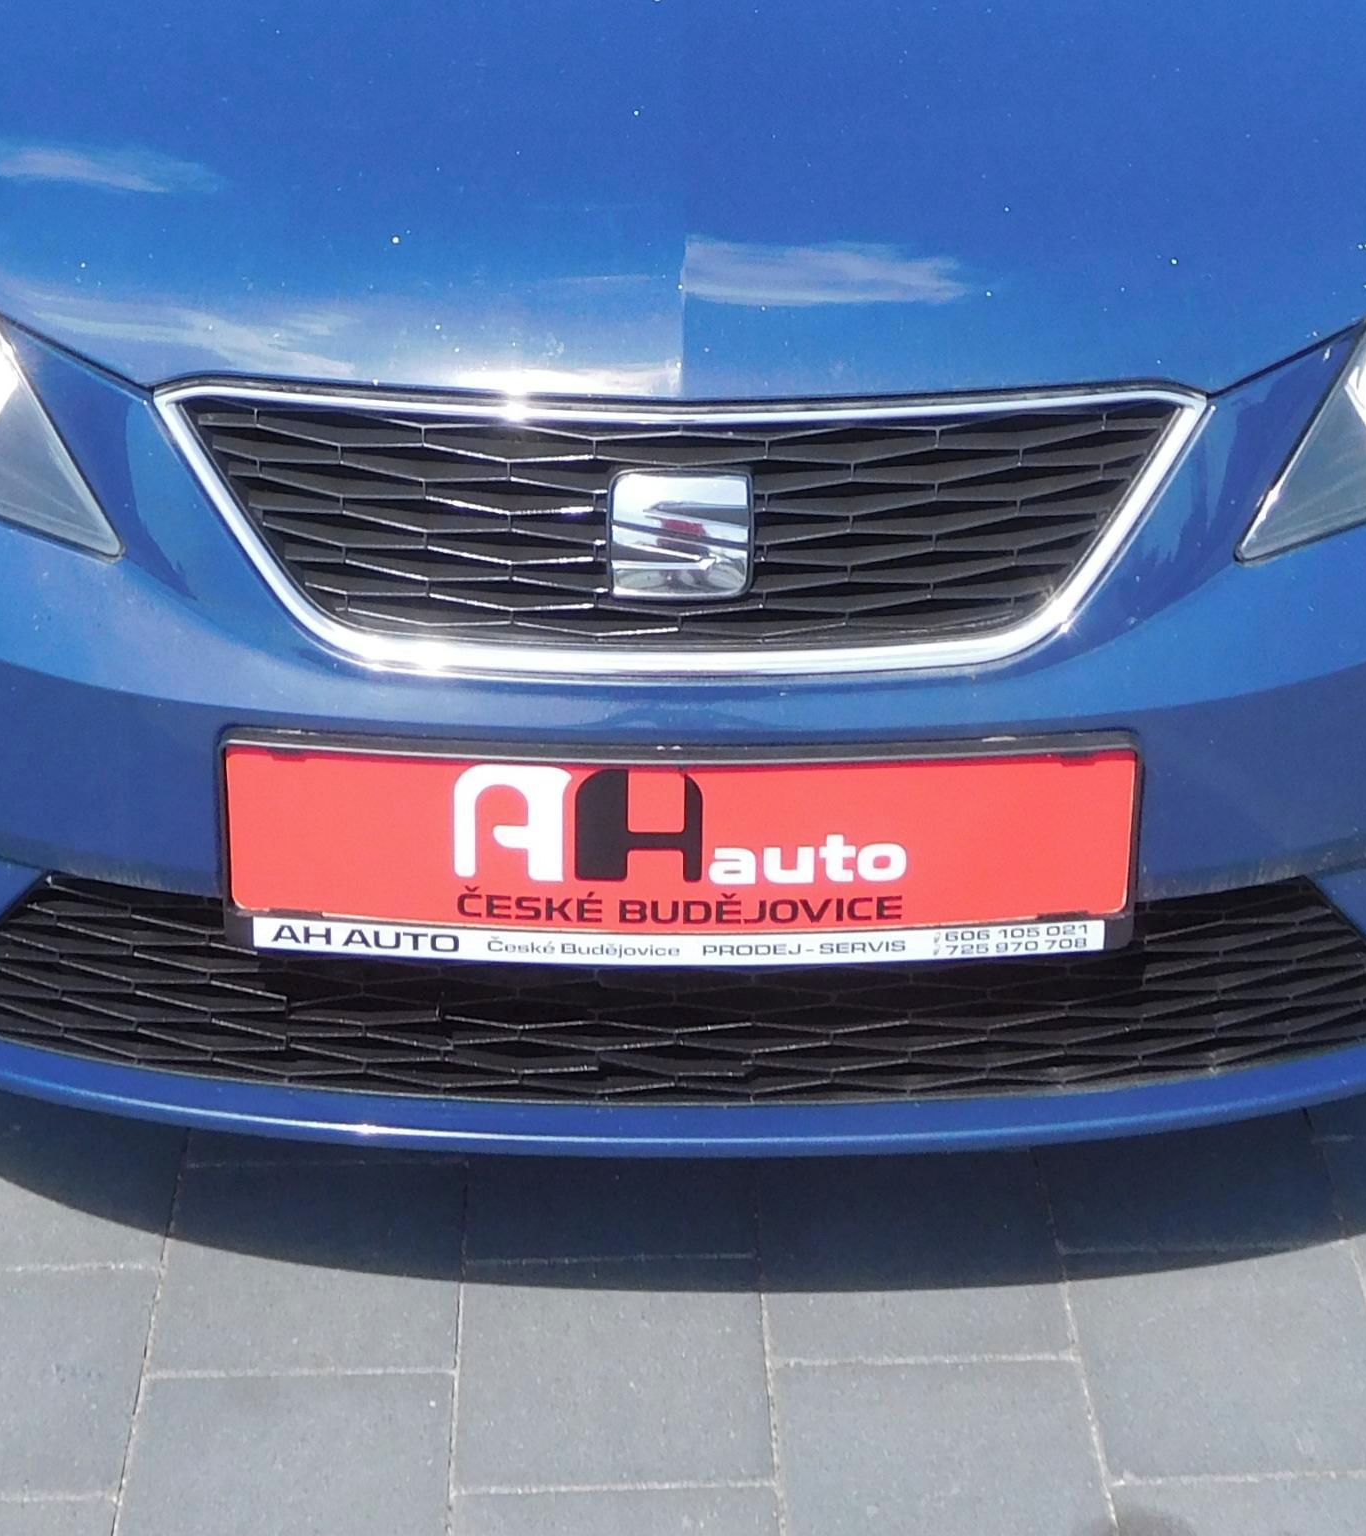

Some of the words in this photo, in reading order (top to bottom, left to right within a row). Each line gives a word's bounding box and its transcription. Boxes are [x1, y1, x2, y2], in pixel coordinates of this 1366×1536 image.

[456, 885, 604, 923] ČESKÉ
[618, 892, 904, 925] BUDĚJOVICE
[271, 924, 332, 946] AH
[341, 928, 460, 953] AUTO
[486, 936, 556, 955] České
[560, 942, 681, 959] Budějovice
[702, 943, 802, 957] PRODEJ
[819, 940, 907, 956] SERVIS
[945, 929, 990, 942] 606
[998, 926, 1040, 939] 105
[1046, 924, 1088, 937] 021
[995, 940, 1038, 953] 970
[1044, 937, 1087, 950] 708
